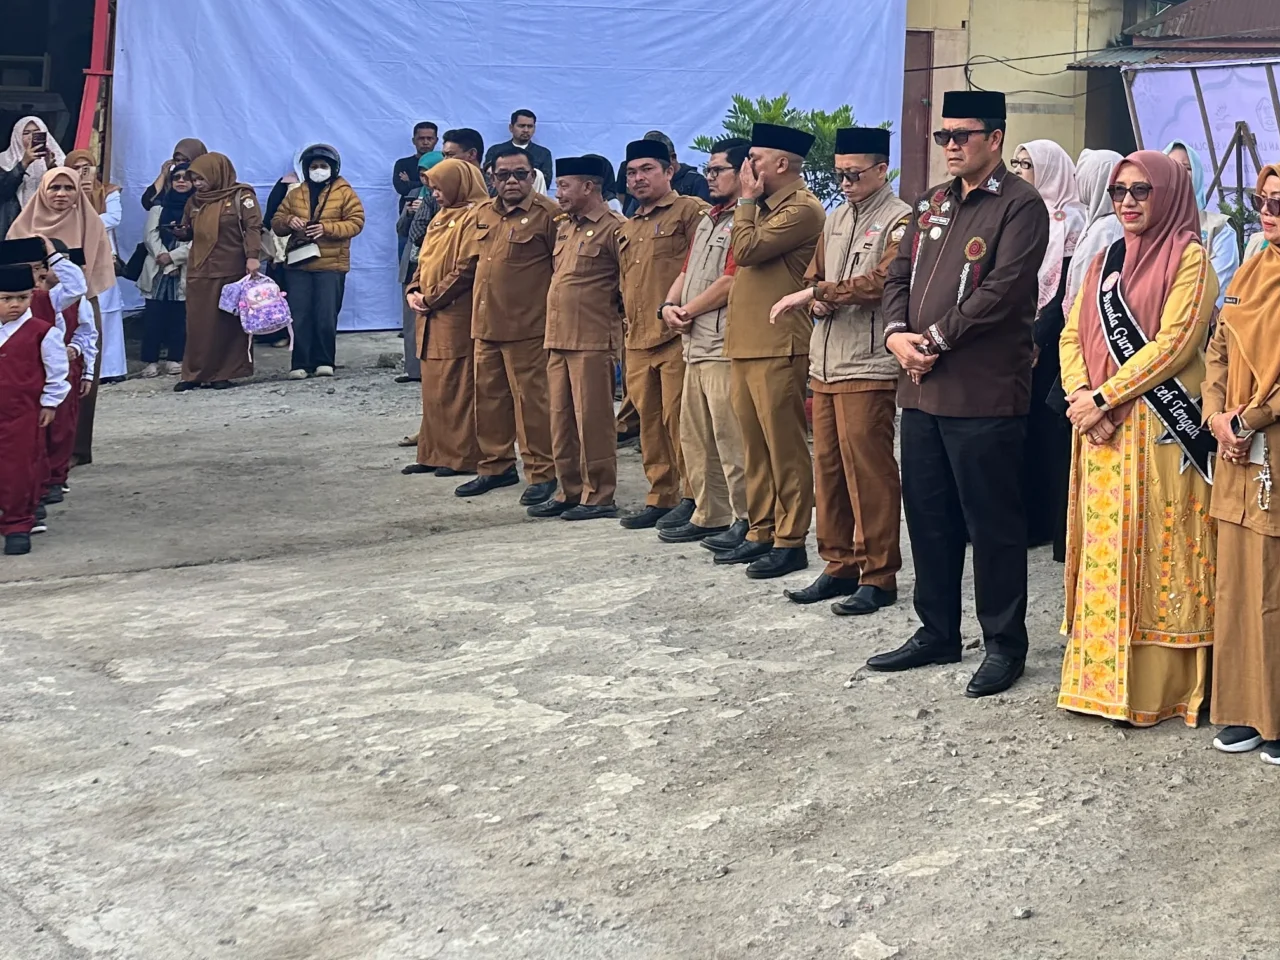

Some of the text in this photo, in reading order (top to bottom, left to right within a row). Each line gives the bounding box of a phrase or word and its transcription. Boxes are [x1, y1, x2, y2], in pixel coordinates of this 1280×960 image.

[1102, 291, 1201, 440] Bunda Guru ceh Tengah
